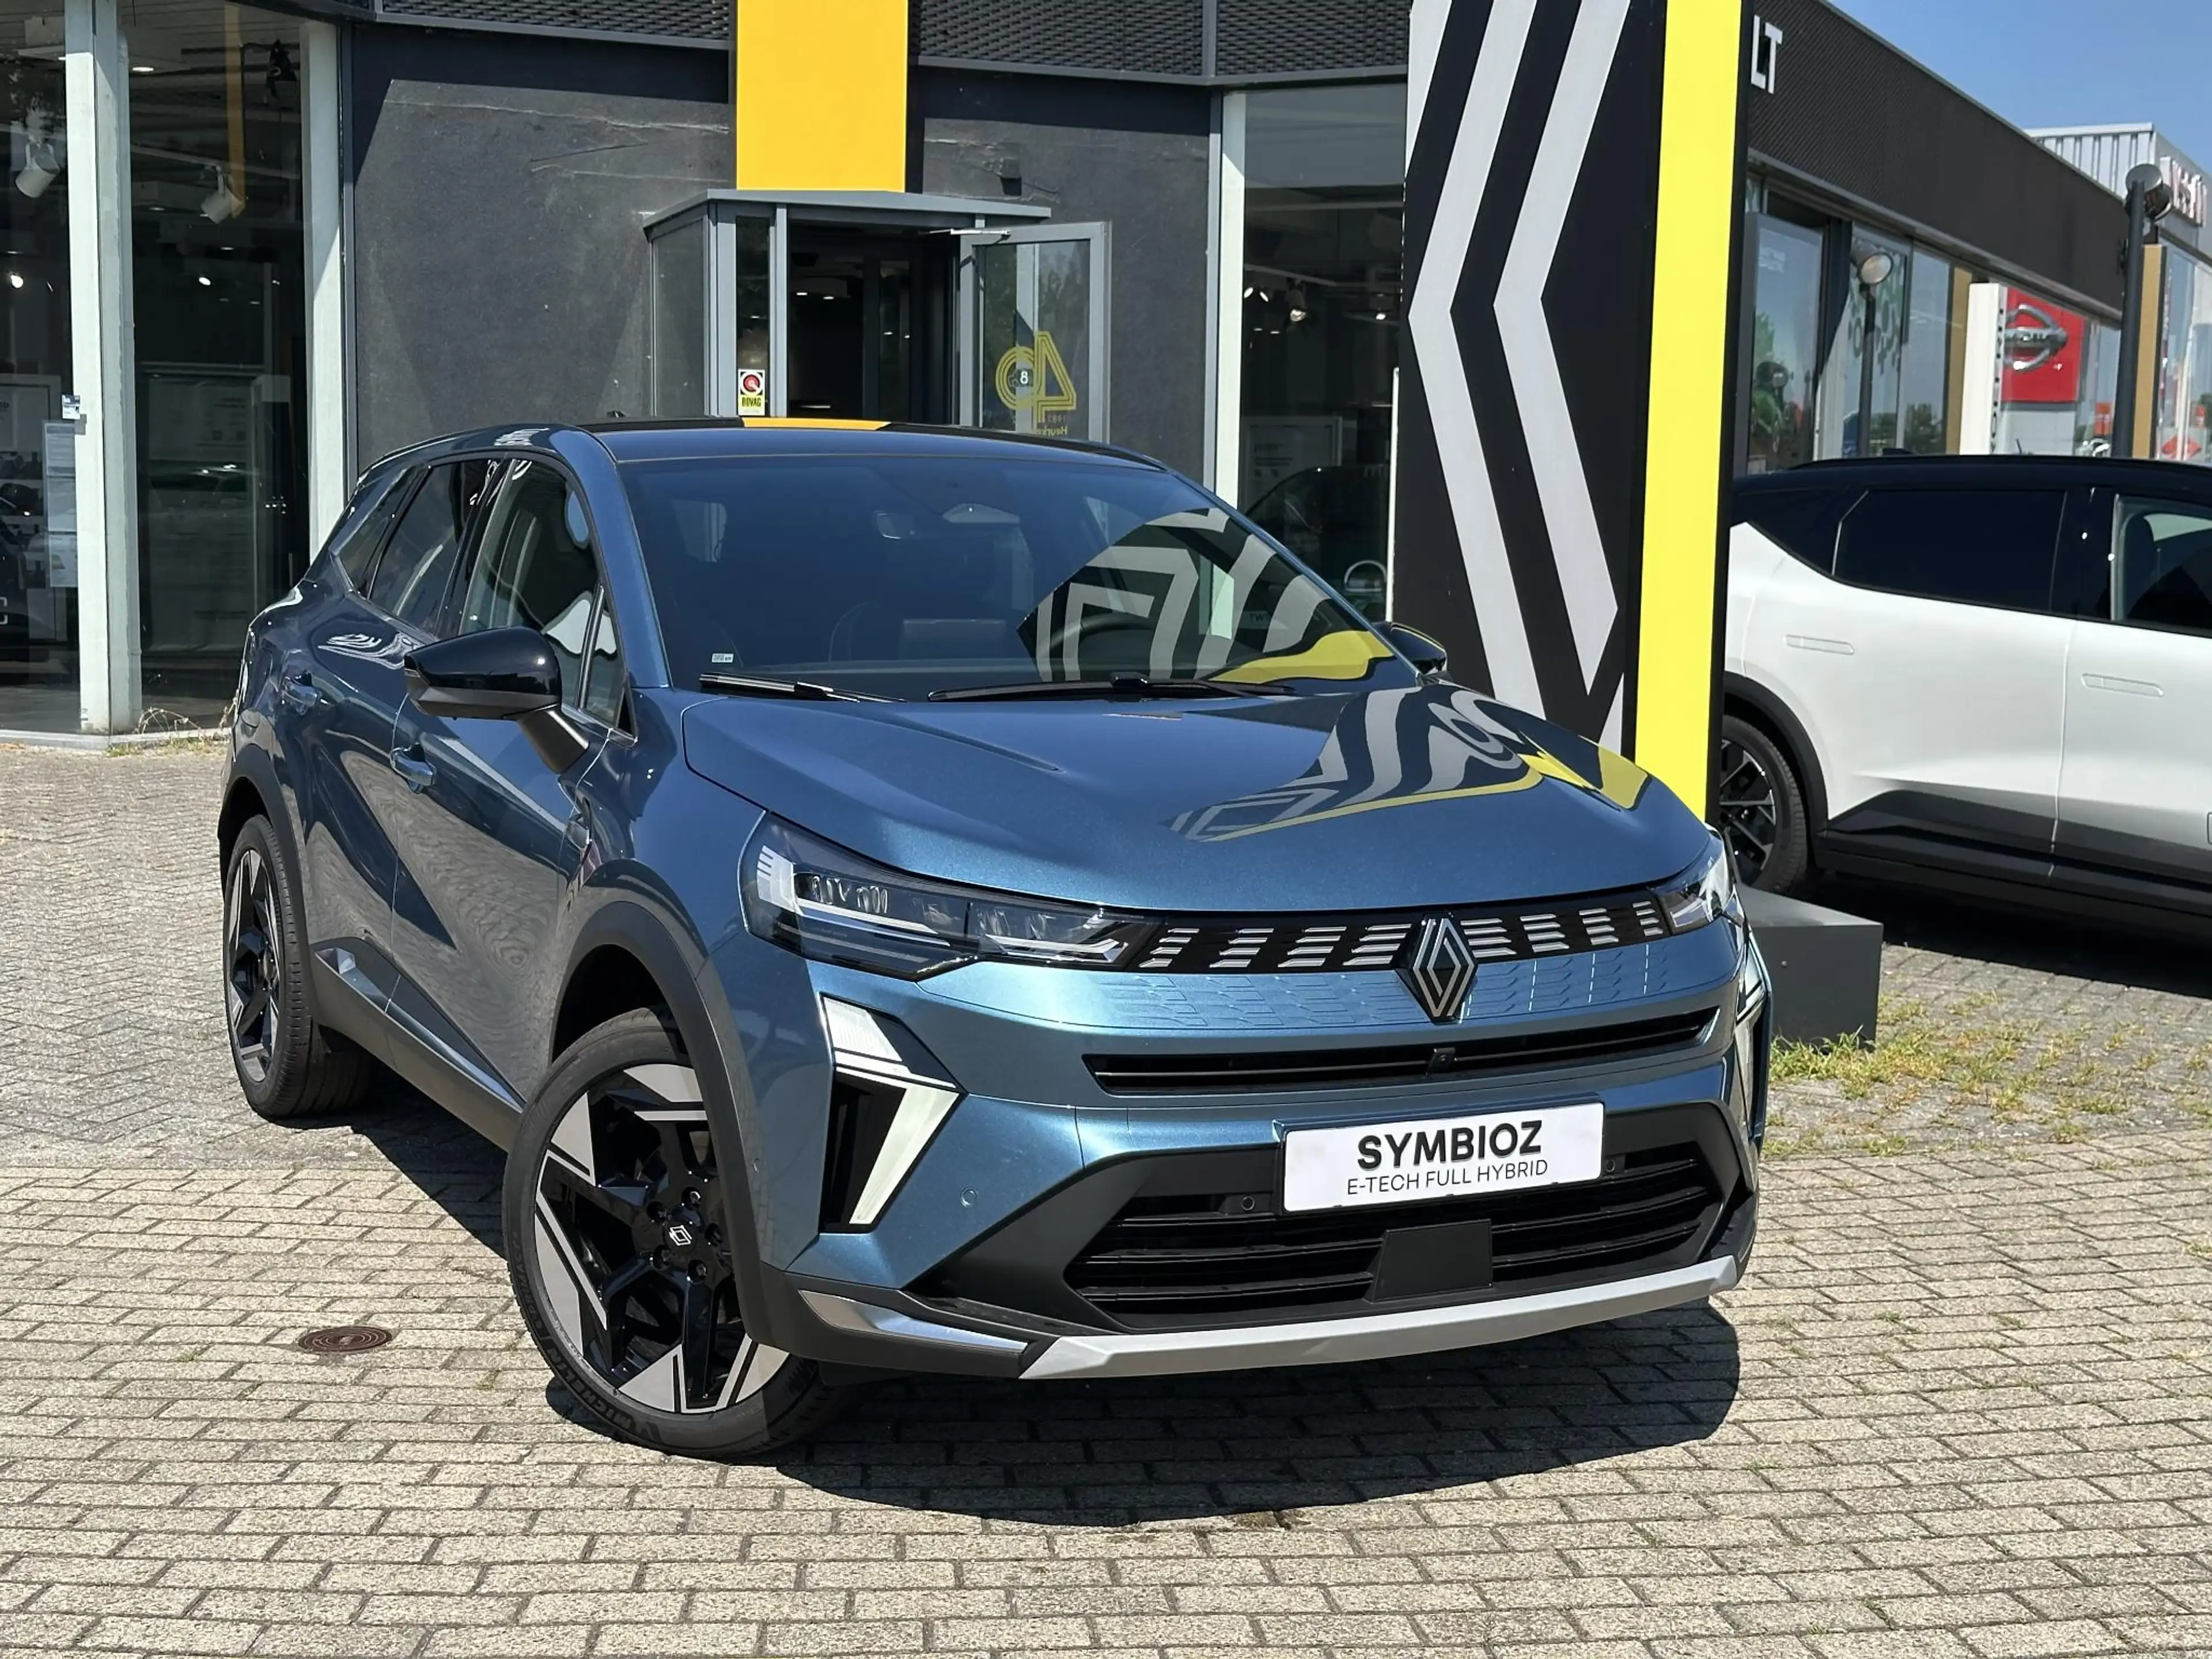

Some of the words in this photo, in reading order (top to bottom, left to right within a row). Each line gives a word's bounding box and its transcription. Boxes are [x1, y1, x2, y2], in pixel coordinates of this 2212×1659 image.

[1357, 1120, 1543, 1171] SYMBIOZ
[1347, 1174, 1420, 1195] E-TECH
[1425, 1168, 1472, 1189] FULL
[1477, 1160, 1548, 1183] HYBRID
[547, 1344, 632, 1430] MICHELIN
